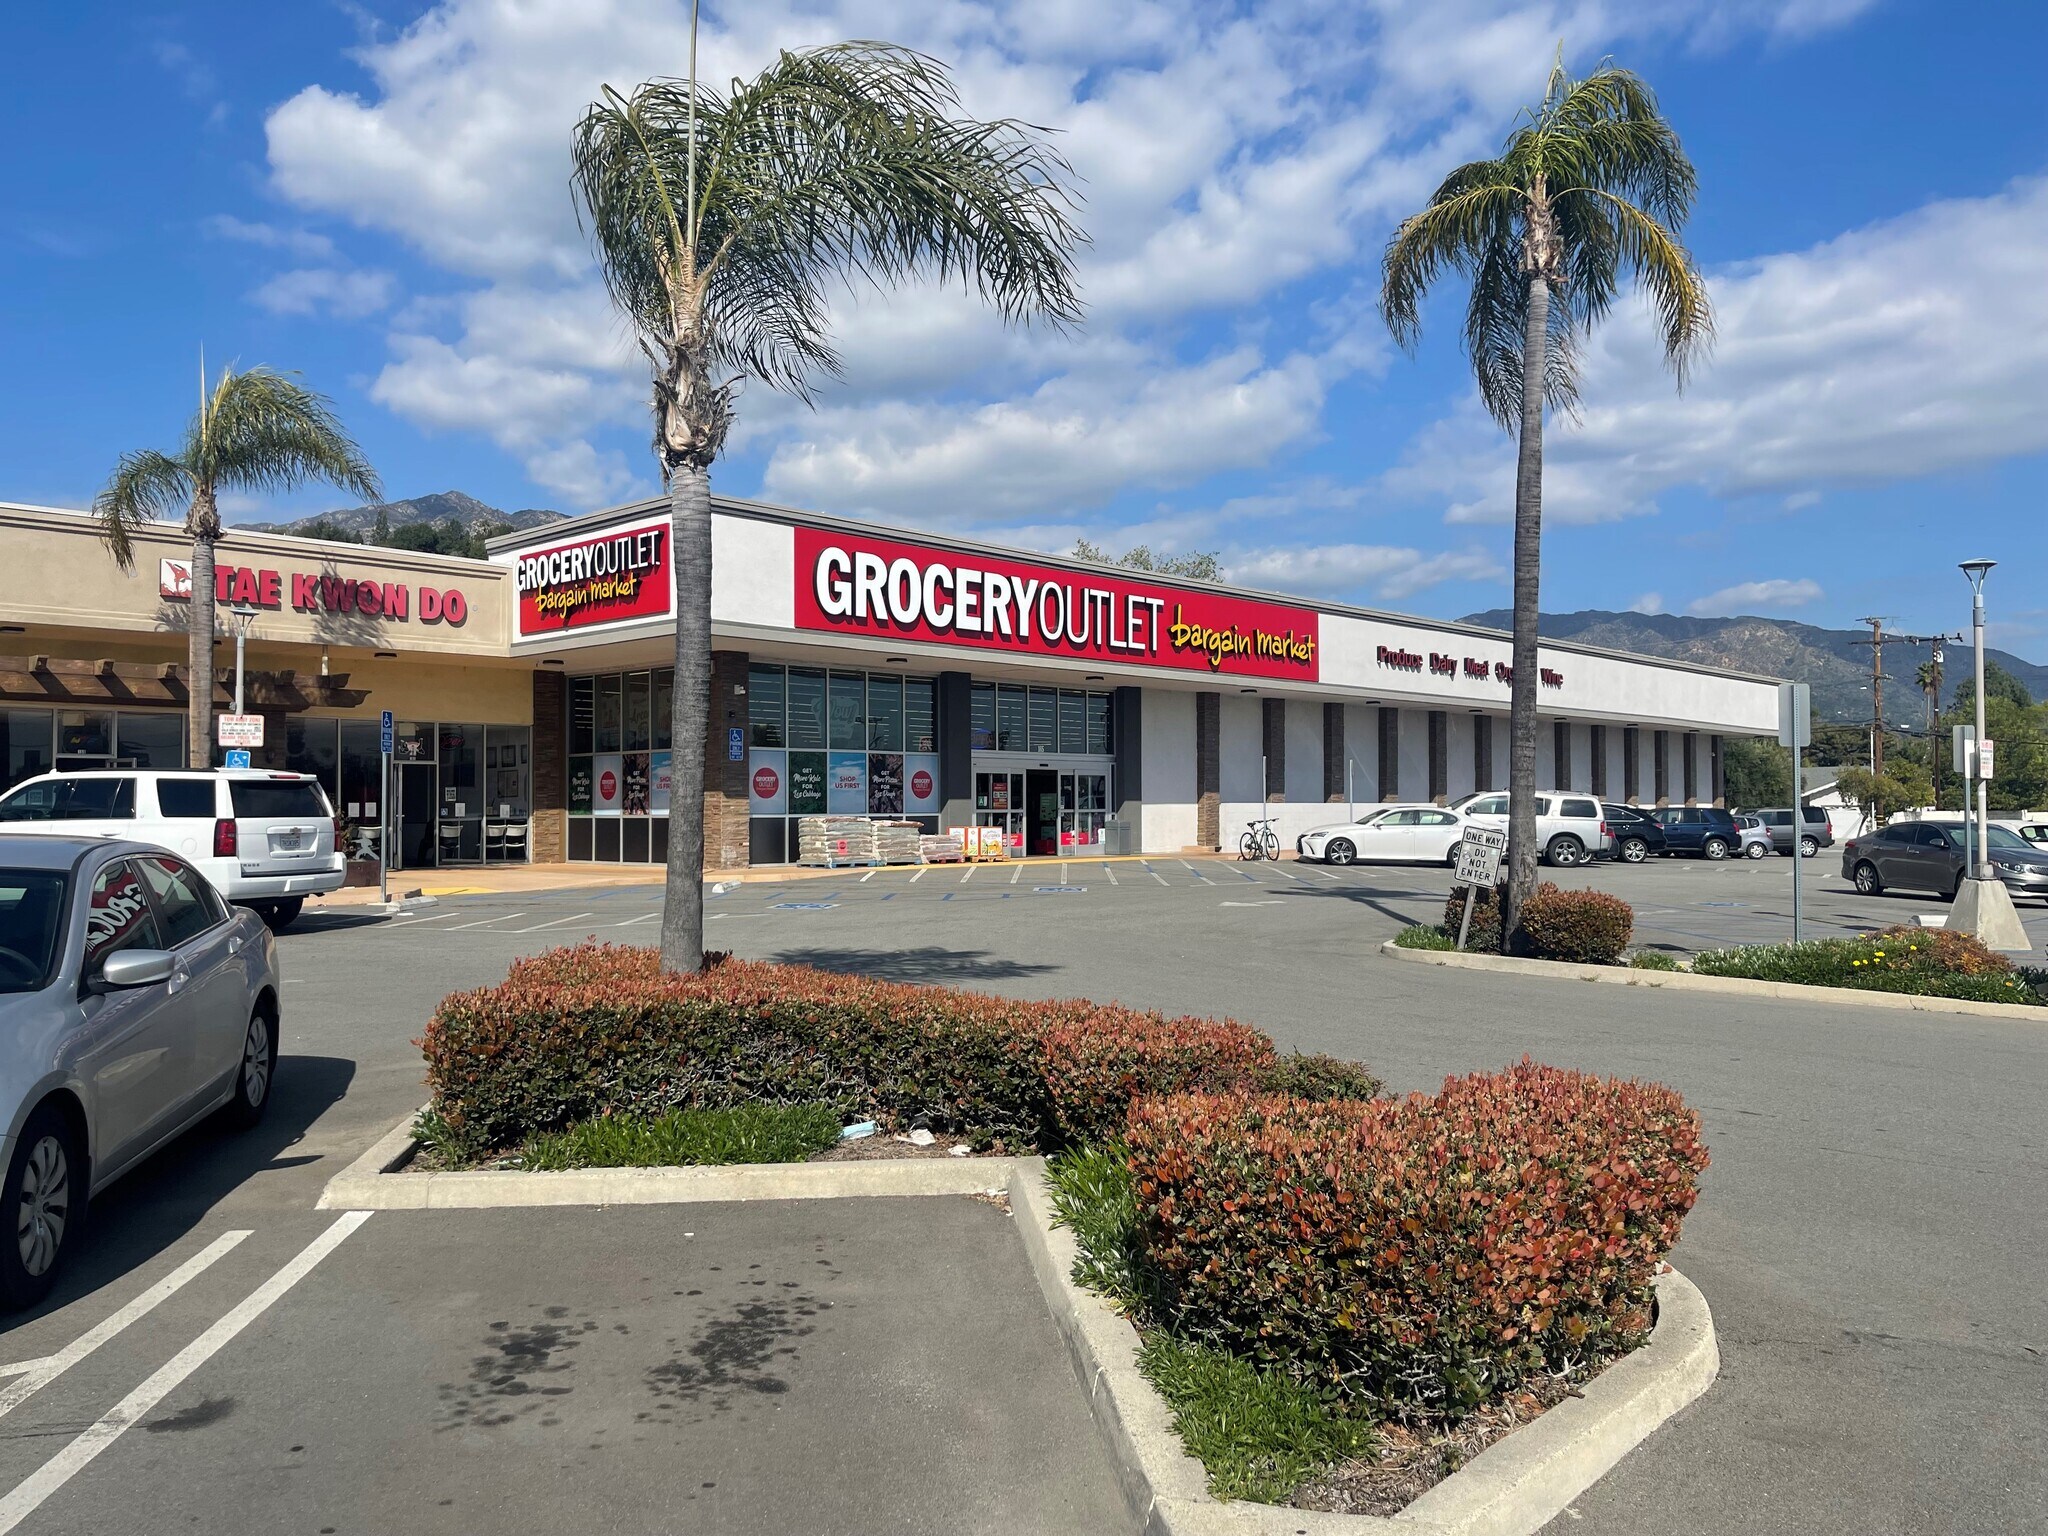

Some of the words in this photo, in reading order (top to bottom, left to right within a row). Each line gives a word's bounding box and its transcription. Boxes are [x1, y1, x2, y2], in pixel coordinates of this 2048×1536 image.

[213, 564, 279, 605] TAE
[292, 573, 408, 617] KWON
[419, 587, 468, 623] DO
[535, 580, 587, 619] bargain
[590, 572, 637, 601] market
[1170, 604, 1251, 667] bargain
[1257, 628, 1316, 662] market
[1377, 646, 1423, 668] Produce
[1431, 653, 1457, 673] Dairy
[1464, 657, 1489, 676] Meat
[1540, 667, 1563, 686] Wine
[1466, 832, 1483, 842] ONE
[1485, 836, 1501, 846] WAY
[1475, 849, 1486, 857] DO
[1469, 858, 1487, 869] NOT
[1461, 868, 1490, 880] ENTER
